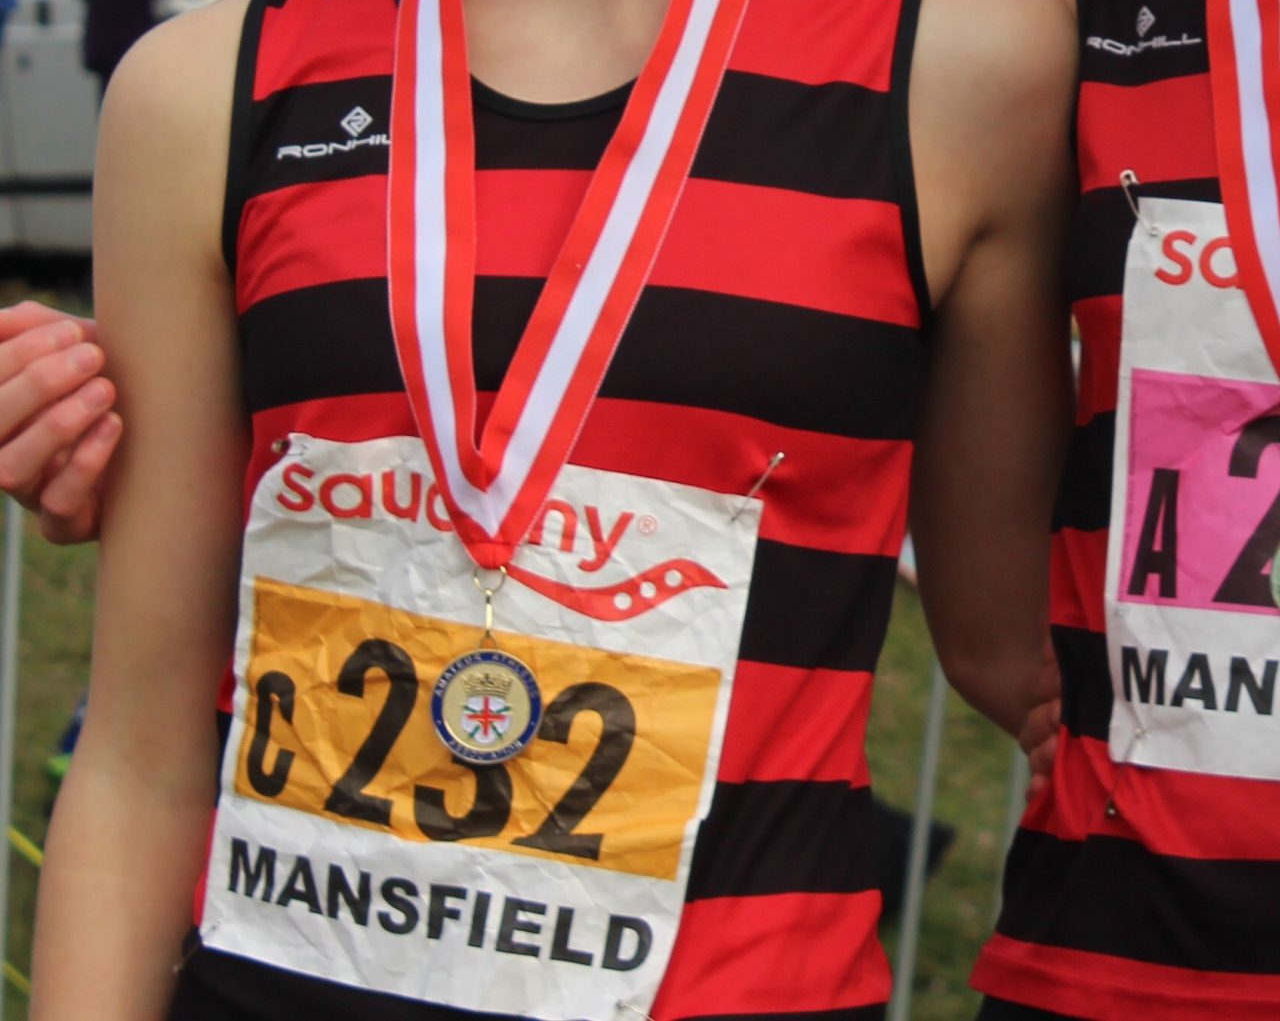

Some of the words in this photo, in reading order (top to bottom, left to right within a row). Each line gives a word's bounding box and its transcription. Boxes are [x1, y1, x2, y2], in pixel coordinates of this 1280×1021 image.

[277, 134, 391, 160] RONHIL
[276, 462, 635, 573] saucny
[1127, 468, 1180, 599] A
[246, 670, 296, 797] C
[227, 836, 653, 972] MANSFIELD
